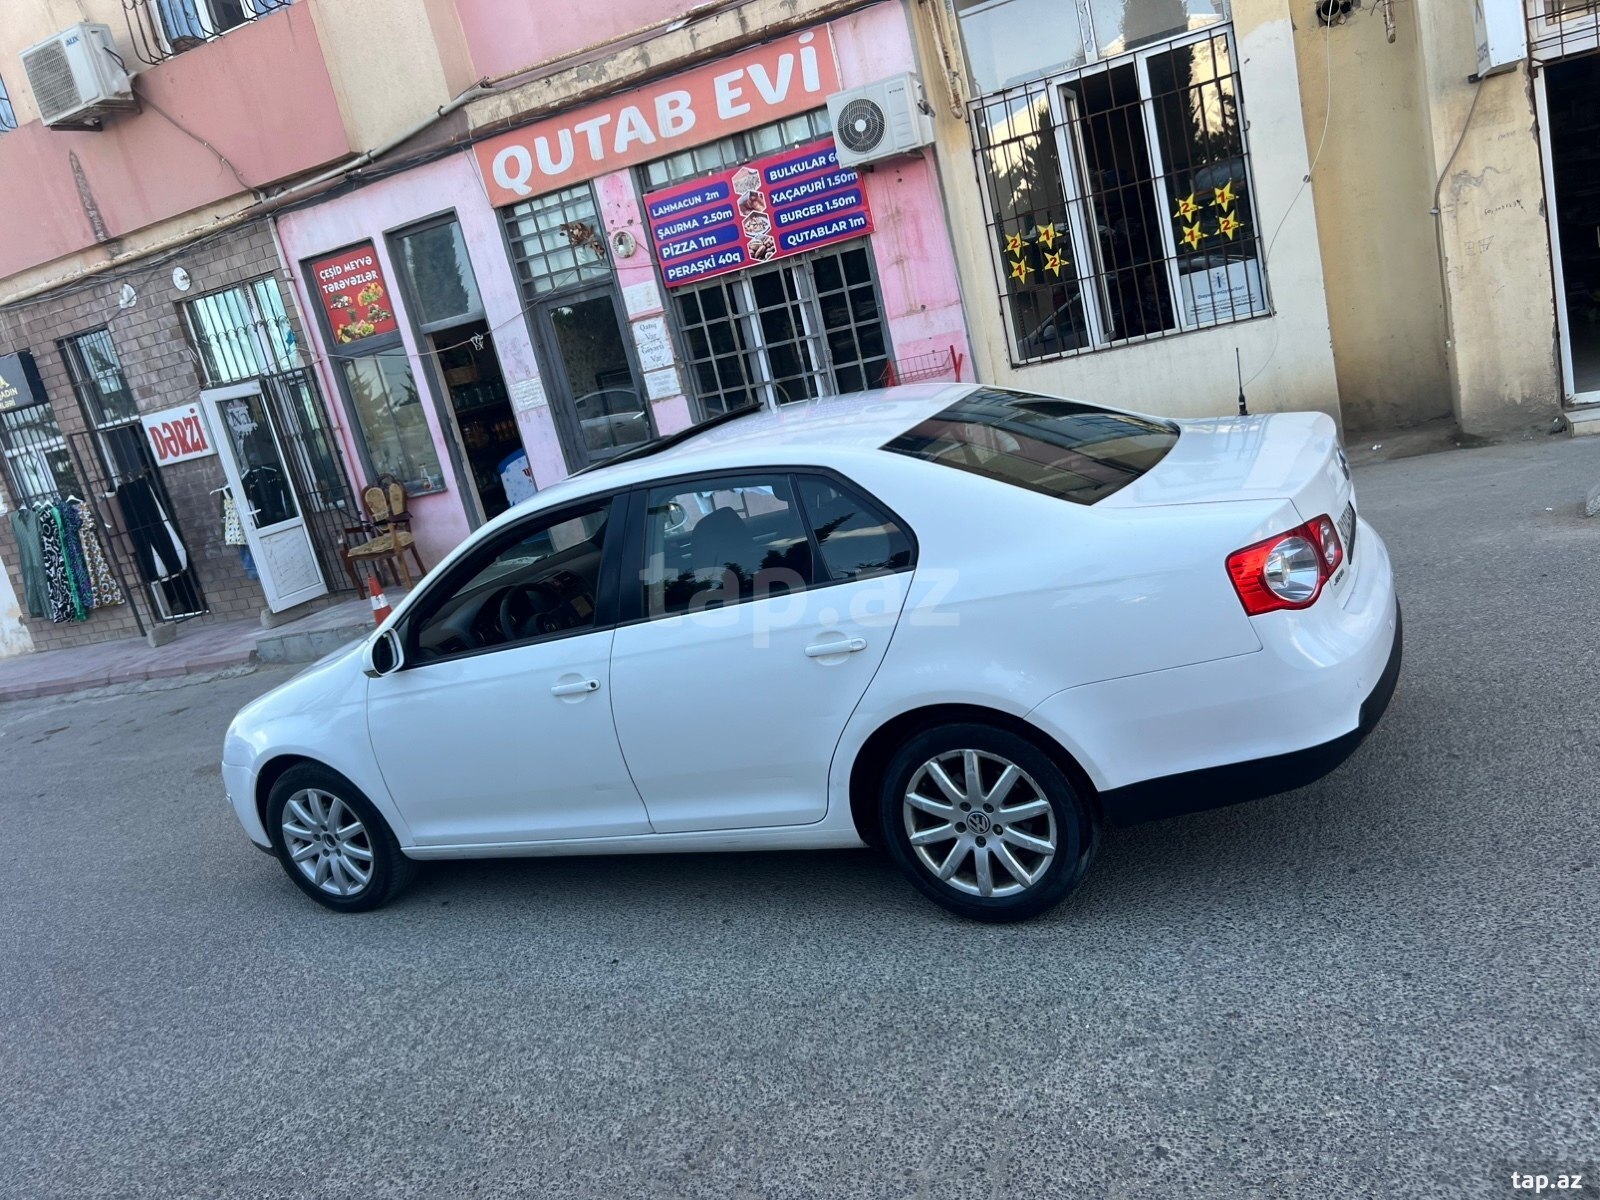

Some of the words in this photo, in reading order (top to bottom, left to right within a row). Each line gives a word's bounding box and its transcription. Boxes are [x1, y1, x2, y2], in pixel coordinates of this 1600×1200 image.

[492, 90, 696, 195] QUTAB
[714, 31, 820, 120] EVİ
[769, 156, 826, 181] BULKULAR
[771, 177, 825, 204] XAÇAPURİ
[827, 171, 858, 187] 1.50m
[652, 195, 701, 217] LAHMACUN
[705, 191, 719, 201] 2m
[780, 204, 823, 223] BURGER
[825, 195, 856, 211] 1.50m
[657, 219, 699, 240] ŞAURMA
[702, 209, 733, 225] 2.50m
[787, 220, 847, 246] QUTABLAR
[848, 216, 865, 228] 1m
[662, 240, 698, 258] PİZZA
[699, 235, 717, 247] 1m
[320, 265, 342, 282] ÇEŞİD
[343, 256, 373, 272] MEYVƏ
[668, 254, 716, 280] PERAŞKİ
[718, 252, 741, 265] 40q
[322, 270, 378, 294] TƏRƏVƏZLƏR
[0, 387, 18, 400] ADIN
[149, 408, 208, 460] DƏRZİ
